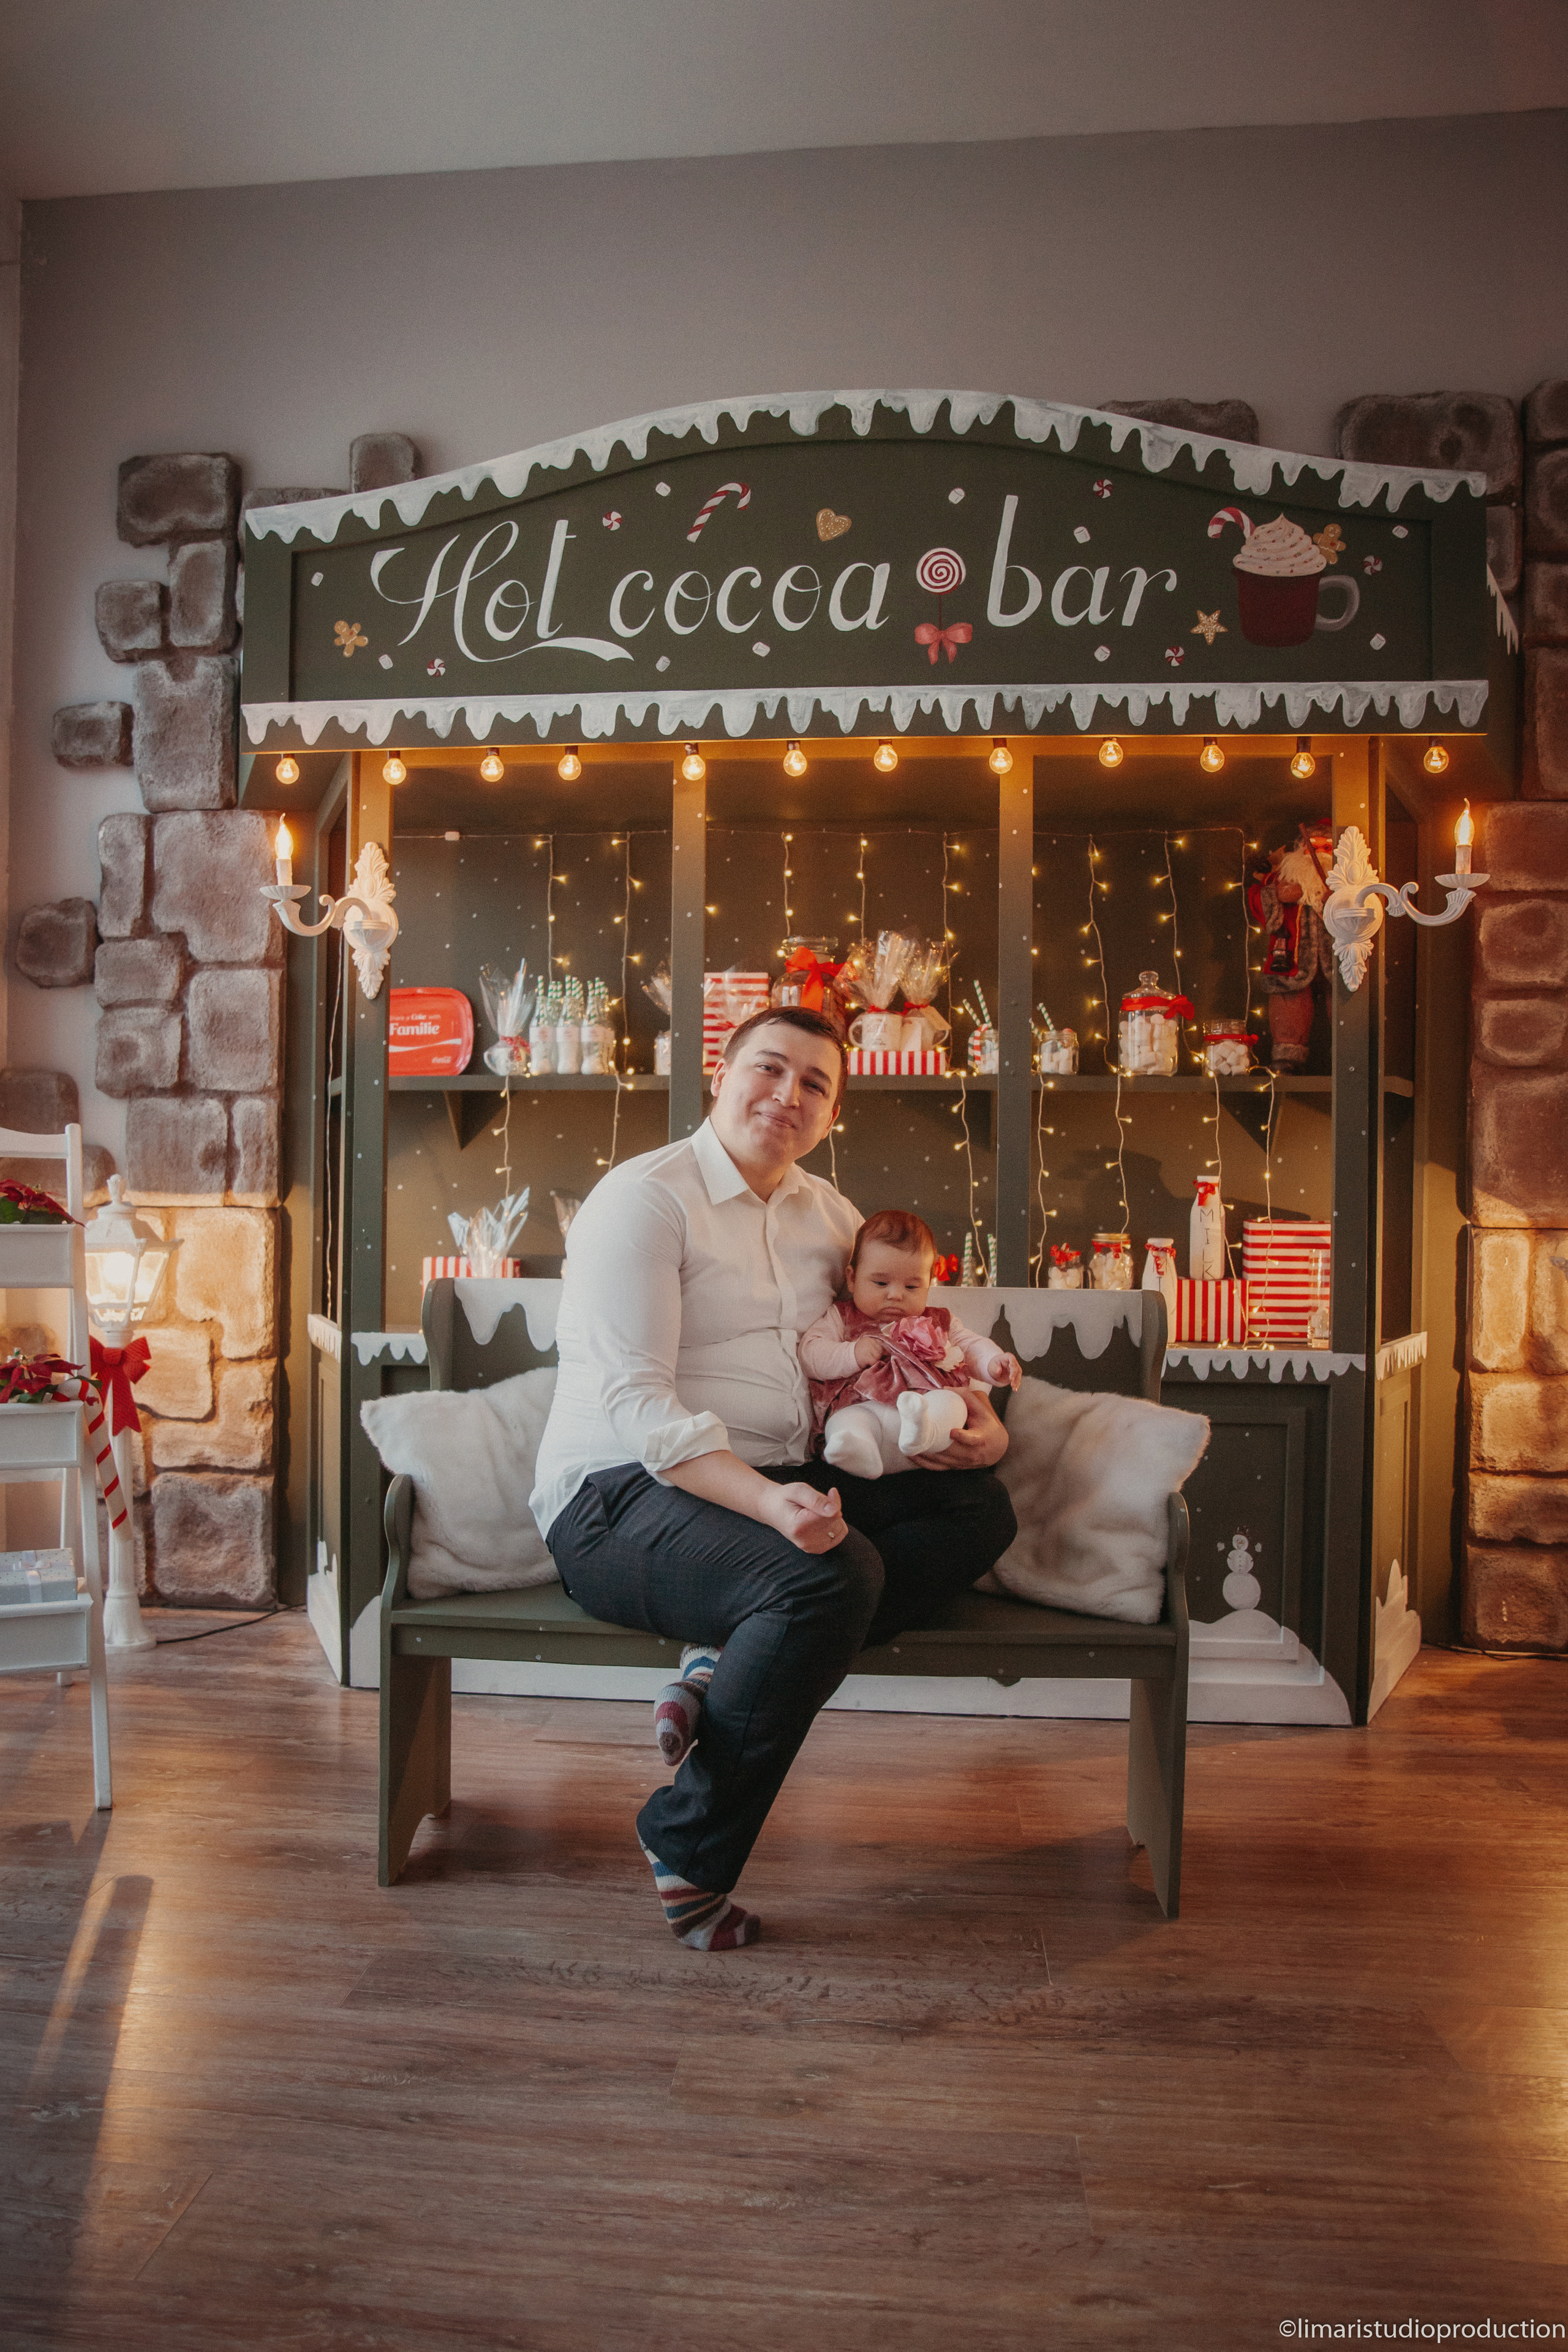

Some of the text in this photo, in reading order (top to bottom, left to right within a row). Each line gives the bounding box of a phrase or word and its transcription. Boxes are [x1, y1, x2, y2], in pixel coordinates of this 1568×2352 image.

[371, 495, 1177, 662] Hot cocoa bar
[389, 1022, 440, 1036] Familie
[1200, 1208, 1215, 1279] MILK
